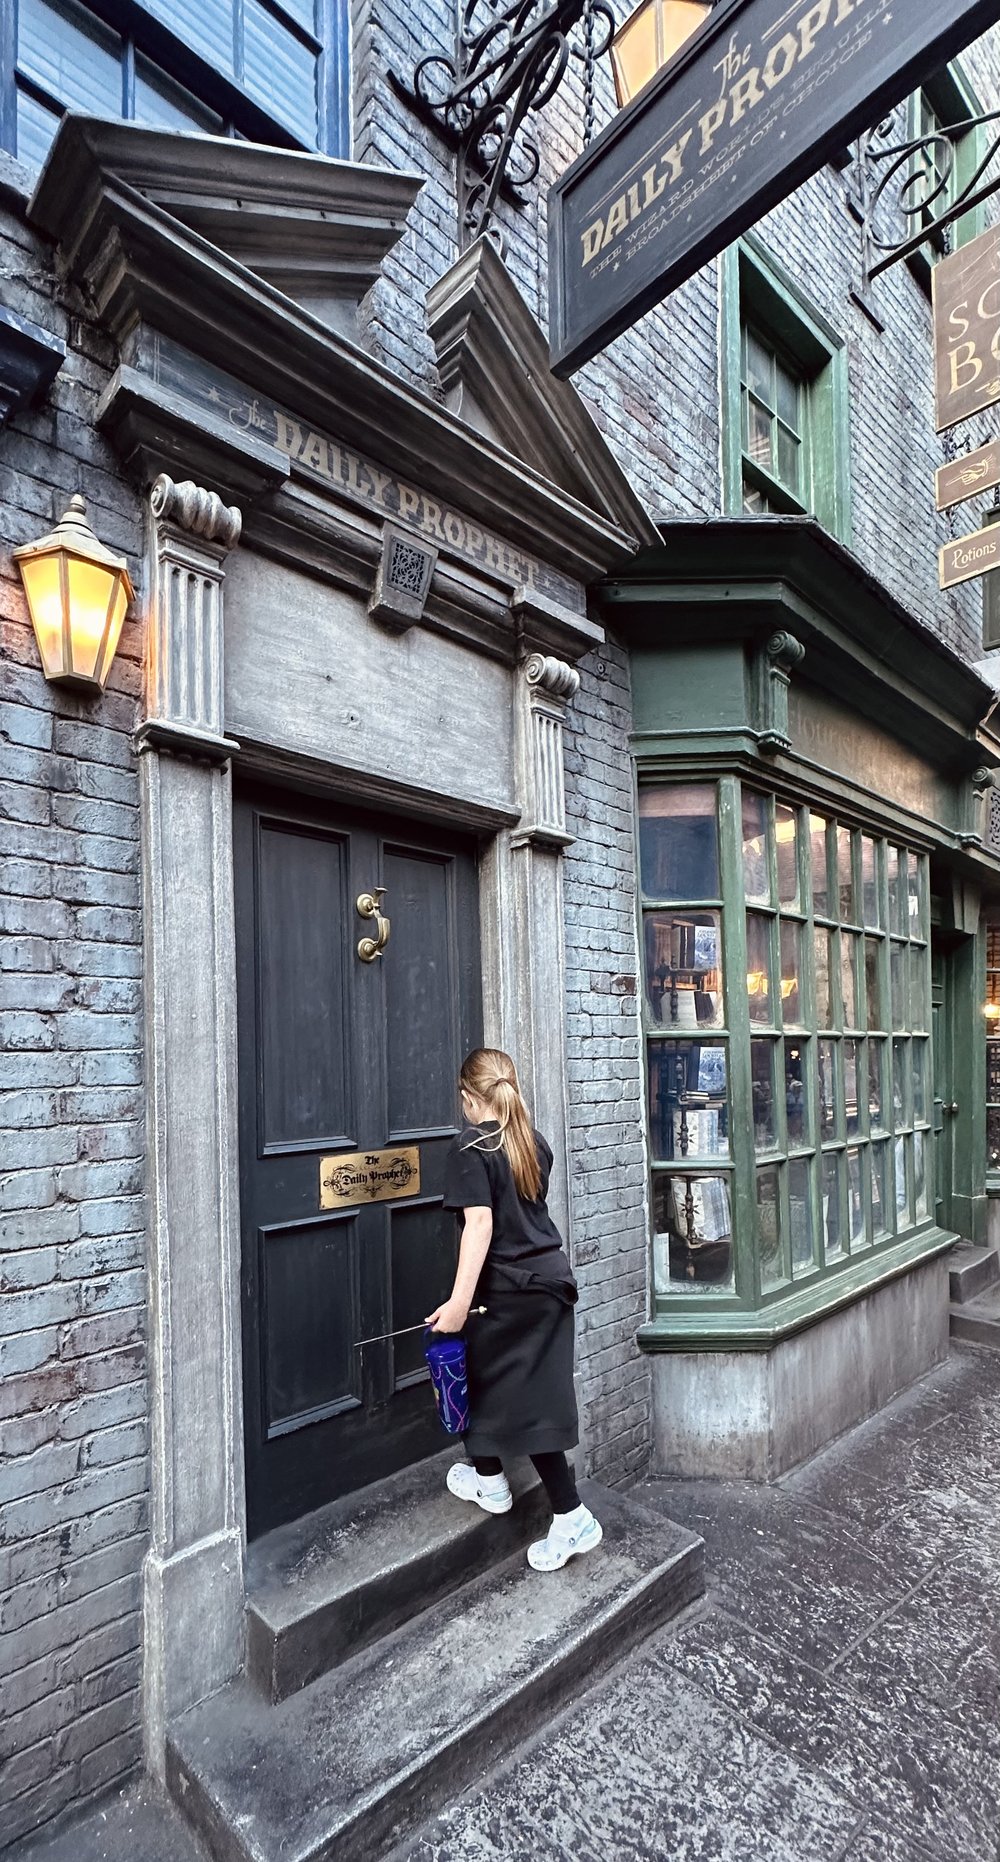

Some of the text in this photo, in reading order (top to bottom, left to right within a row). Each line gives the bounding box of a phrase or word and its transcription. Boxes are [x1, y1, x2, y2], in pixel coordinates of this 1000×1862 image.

[713, 31, 751, 100] The
[626, 29, 872, 261] BROADSHEET OF CHOICE
[580, 128, 692, 267] DAILY
[590, 245, 622, 279] THE
[625, 178, 694, 243] WIZARD
[229, 400, 539, 590] The DAILY PROPHET
[951, 541, 997, 568] Potions
[342, 1173, 367, 1185] Daily
[365, 1156, 379, 1166] The
